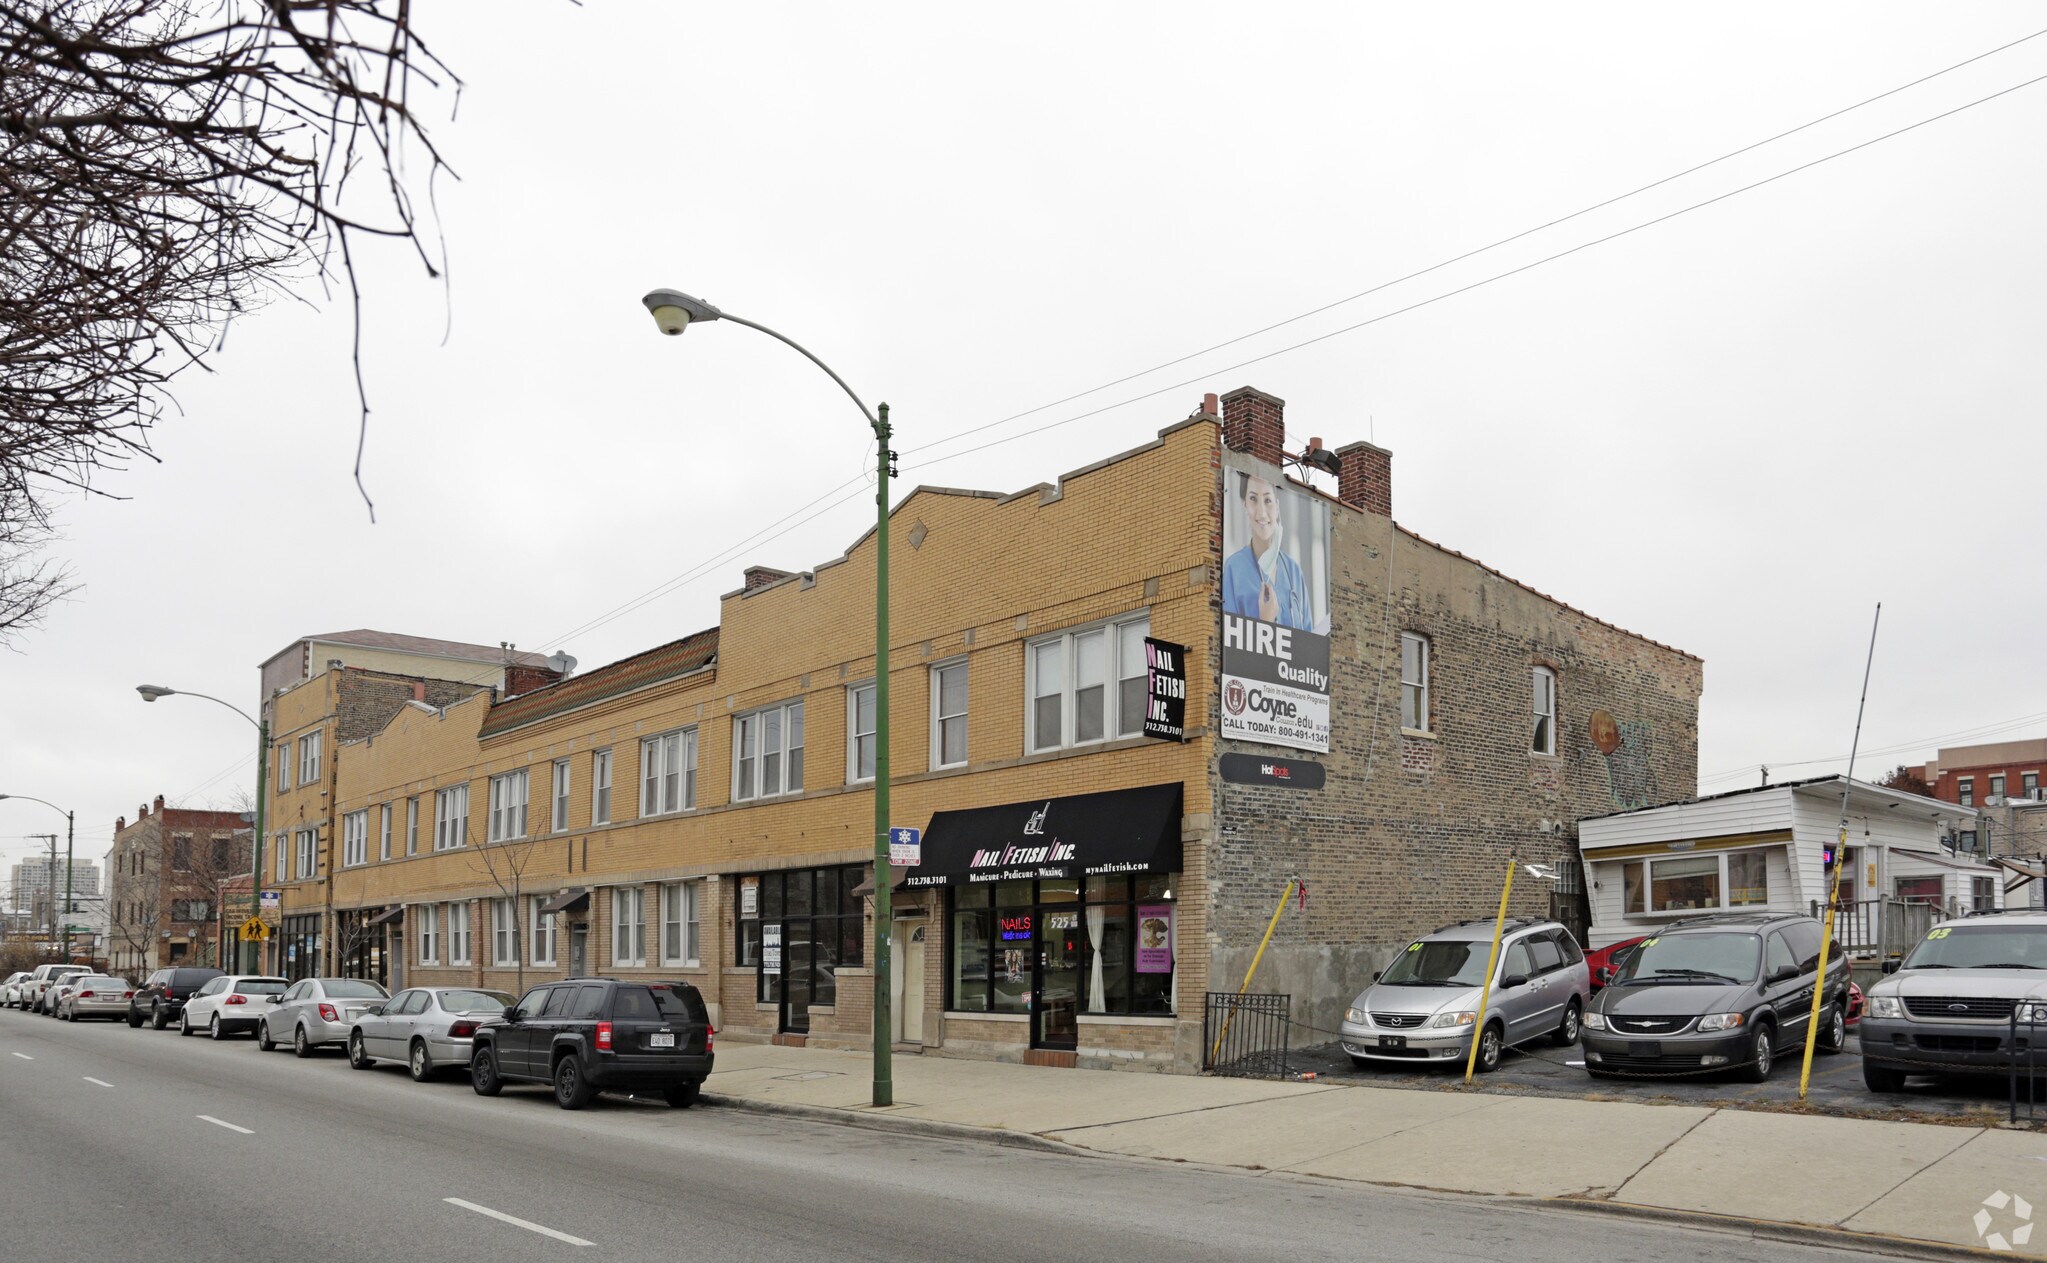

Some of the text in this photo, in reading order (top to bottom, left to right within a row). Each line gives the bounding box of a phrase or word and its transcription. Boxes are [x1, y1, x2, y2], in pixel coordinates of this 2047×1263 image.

[1224, 614, 1292, 660] HIRE
[1146, 643, 1174, 671] NAIL
[1148, 668, 1185, 699] FETISH
[1278, 661, 1328, 692] Quality
[1147, 694, 1169, 722] INC.
[1263, 685, 1275, 694] Train
[1282, 689, 1306, 701] Healthcare
[1307, 695, 1328, 706] Programs
[1223, 718, 1245, 730] CALL
[1247, 721, 1276, 735] TODAY:
[1278, 727, 1328, 743] 800-491-1341
[907, 875, 947, 886] 312.738.3101
[764, 926, 781, 935] AVAILABL
[1001, 917, 1031, 930] NAILS
[1051, 917, 1068, 929] 525
